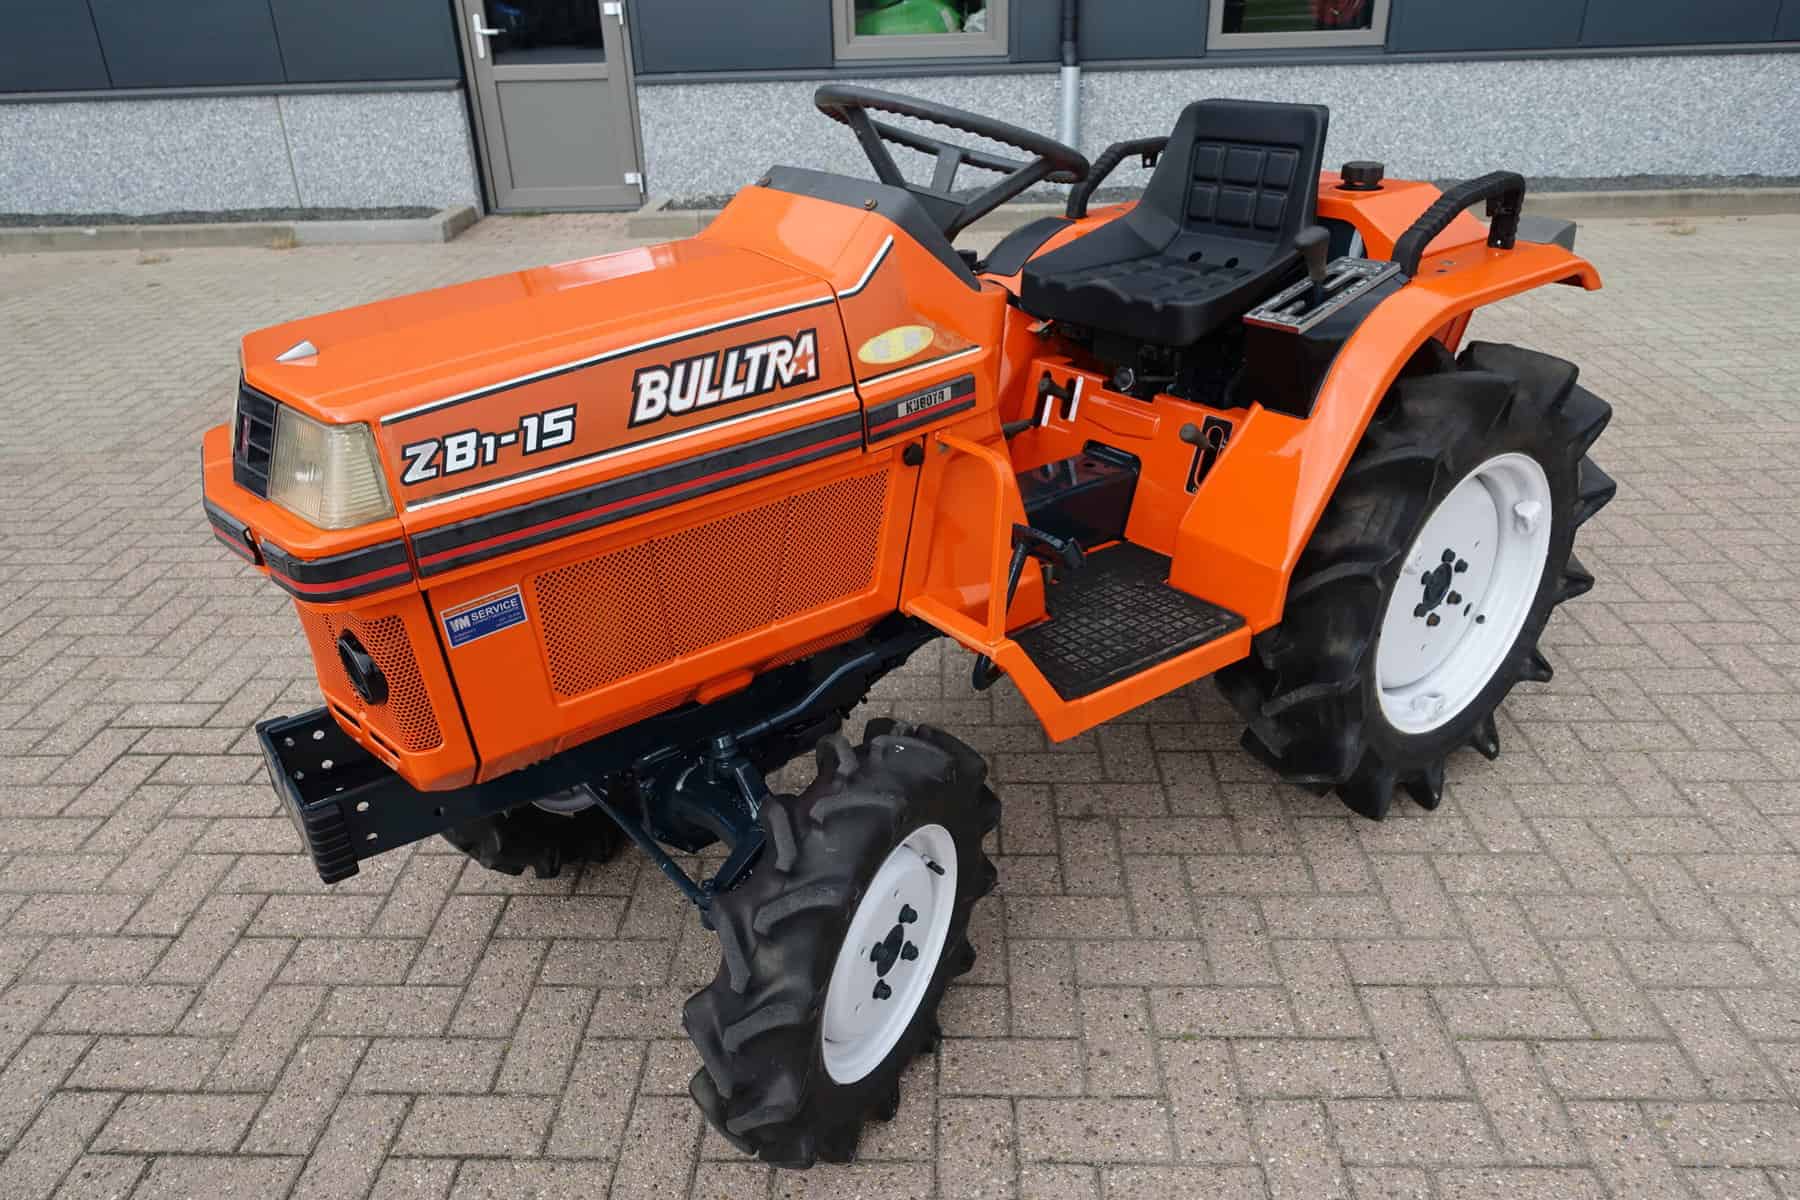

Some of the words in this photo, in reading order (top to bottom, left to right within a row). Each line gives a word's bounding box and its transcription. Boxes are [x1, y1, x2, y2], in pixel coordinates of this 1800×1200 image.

[629, 329, 819, 428] BULLTRA
[905, 390, 945, 414] KUBOTA
[402, 404, 577, 485] ZB1-15
[471, 598, 518, 621] SERVICE
